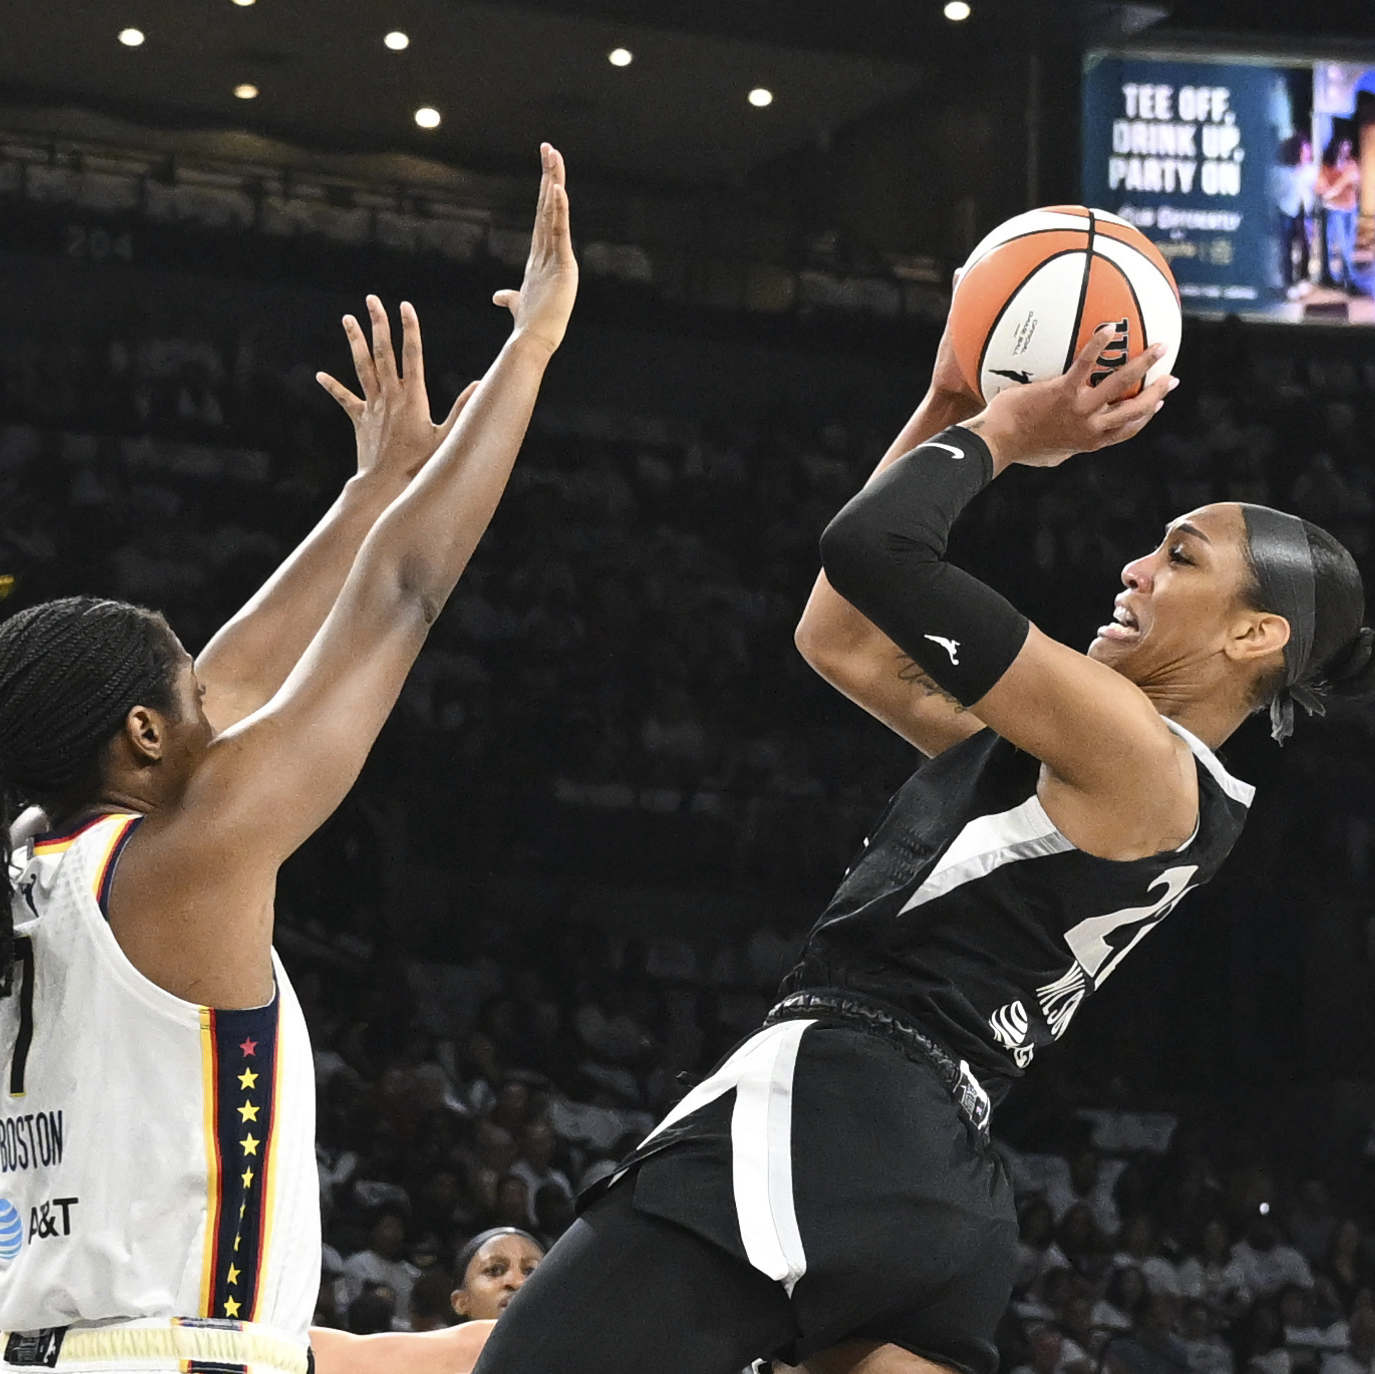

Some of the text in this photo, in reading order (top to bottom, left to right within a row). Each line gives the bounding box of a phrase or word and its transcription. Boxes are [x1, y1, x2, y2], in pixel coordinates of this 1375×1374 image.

[1122, 82, 1237, 125] TEE OFF,
[1112, 120, 1246, 163] DRINK UP,
[1108, 156, 1242, 197] PARTY ON
